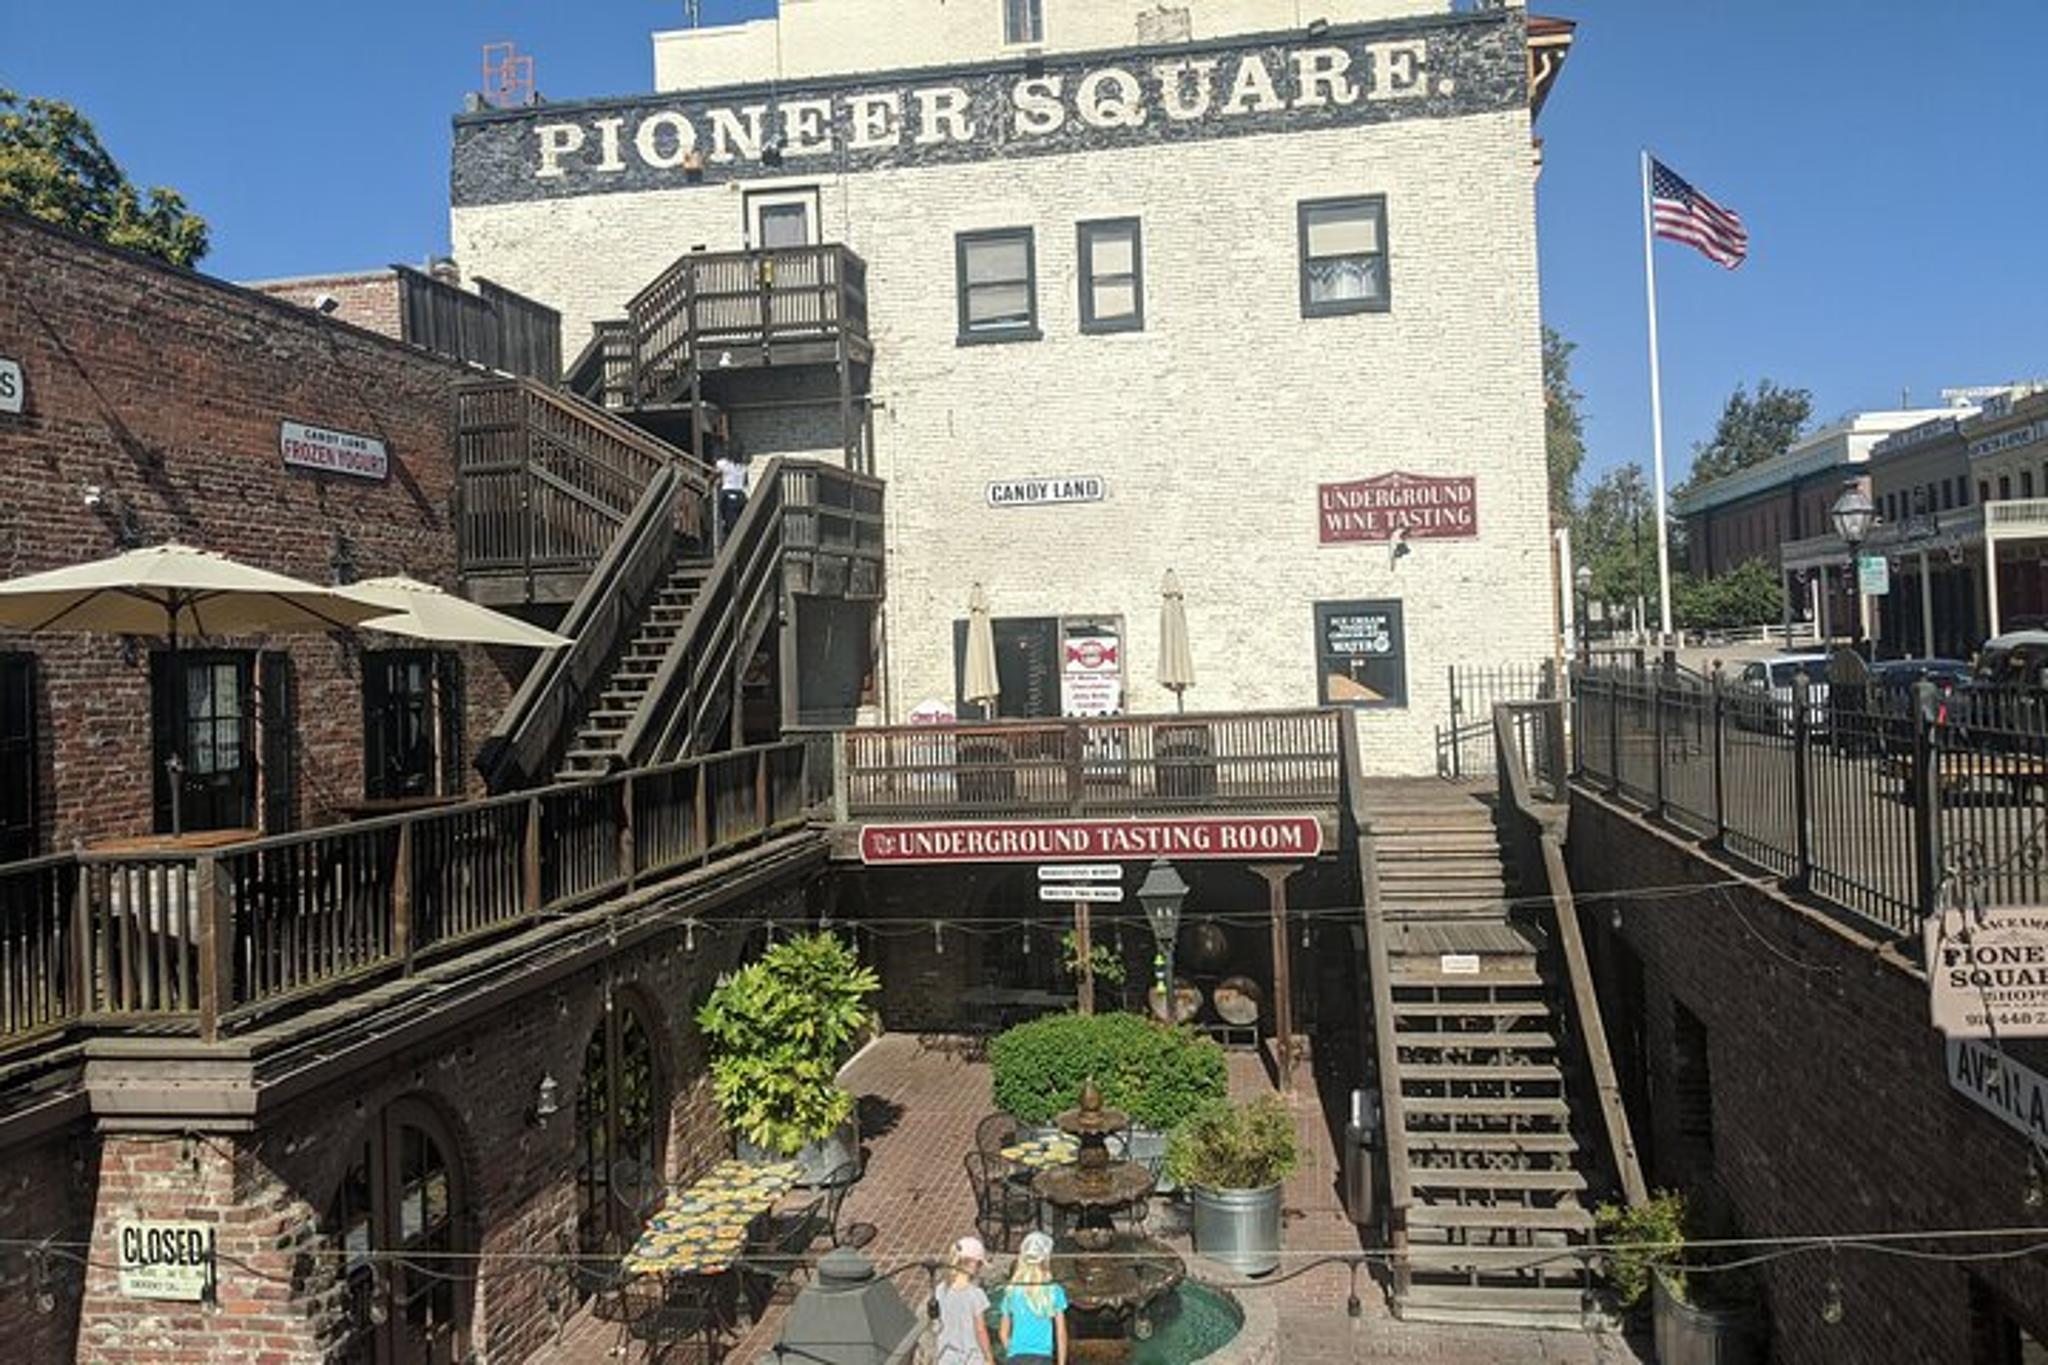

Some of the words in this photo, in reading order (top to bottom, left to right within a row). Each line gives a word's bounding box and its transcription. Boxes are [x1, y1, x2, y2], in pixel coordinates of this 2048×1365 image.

[533, 87, 977, 178] PIONEER
[1012, 38, 1457, 135] SQUARE.
[992, 482, 1048, 501] CANDY
[1054, 480, 1099, 499] LAND
[1322, 485, 1472, 510] UNDERGROUND
[1325, 511, 1378, 530] WINE
[1385, 506, 1472, 528] TASTING
[900, 829, 1090, 854] UNDERGROUND
[1097, 825, 1210, 851] TASTING
[1220, 824, 1303, 849] ROOM
[1943, 945, 2048, 968] PIONE
[124, 1227, 203, 1266] CLOSED
